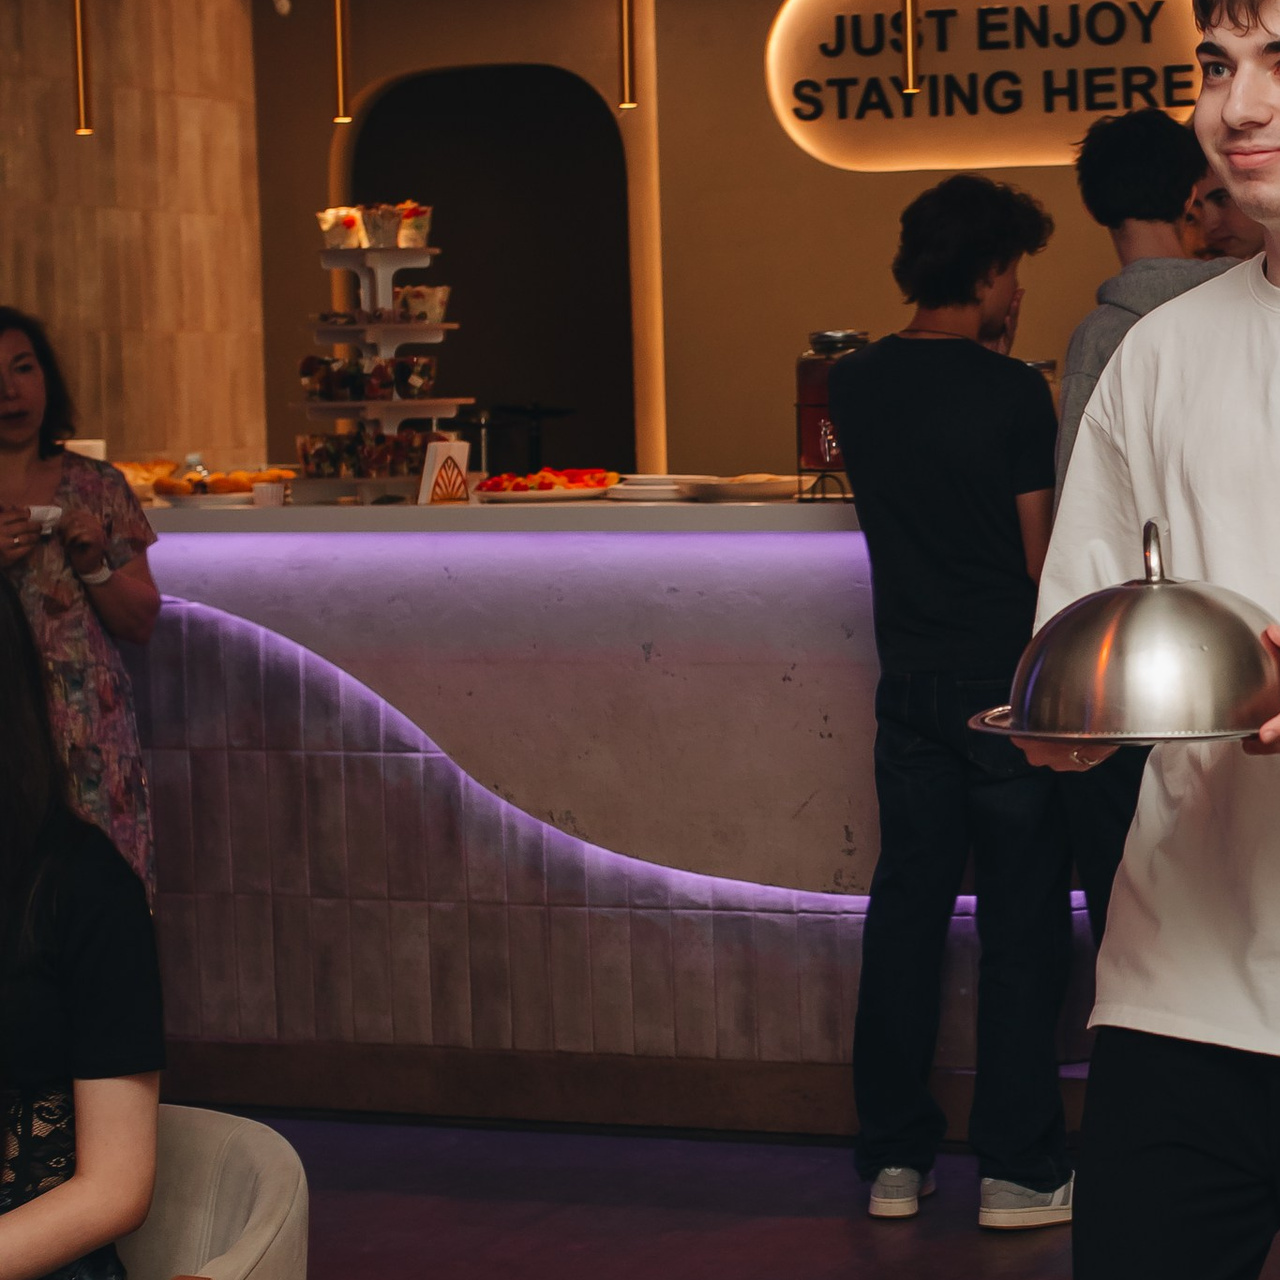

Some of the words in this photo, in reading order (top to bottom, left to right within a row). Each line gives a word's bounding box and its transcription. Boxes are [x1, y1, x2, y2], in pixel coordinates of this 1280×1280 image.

[819, 9, 957, 58] JUST
[977, 0, 1165, 52] ENJOY
[792, 70, 1023, 121] STAYING
[1043, 63, 1196, 114] HERE
